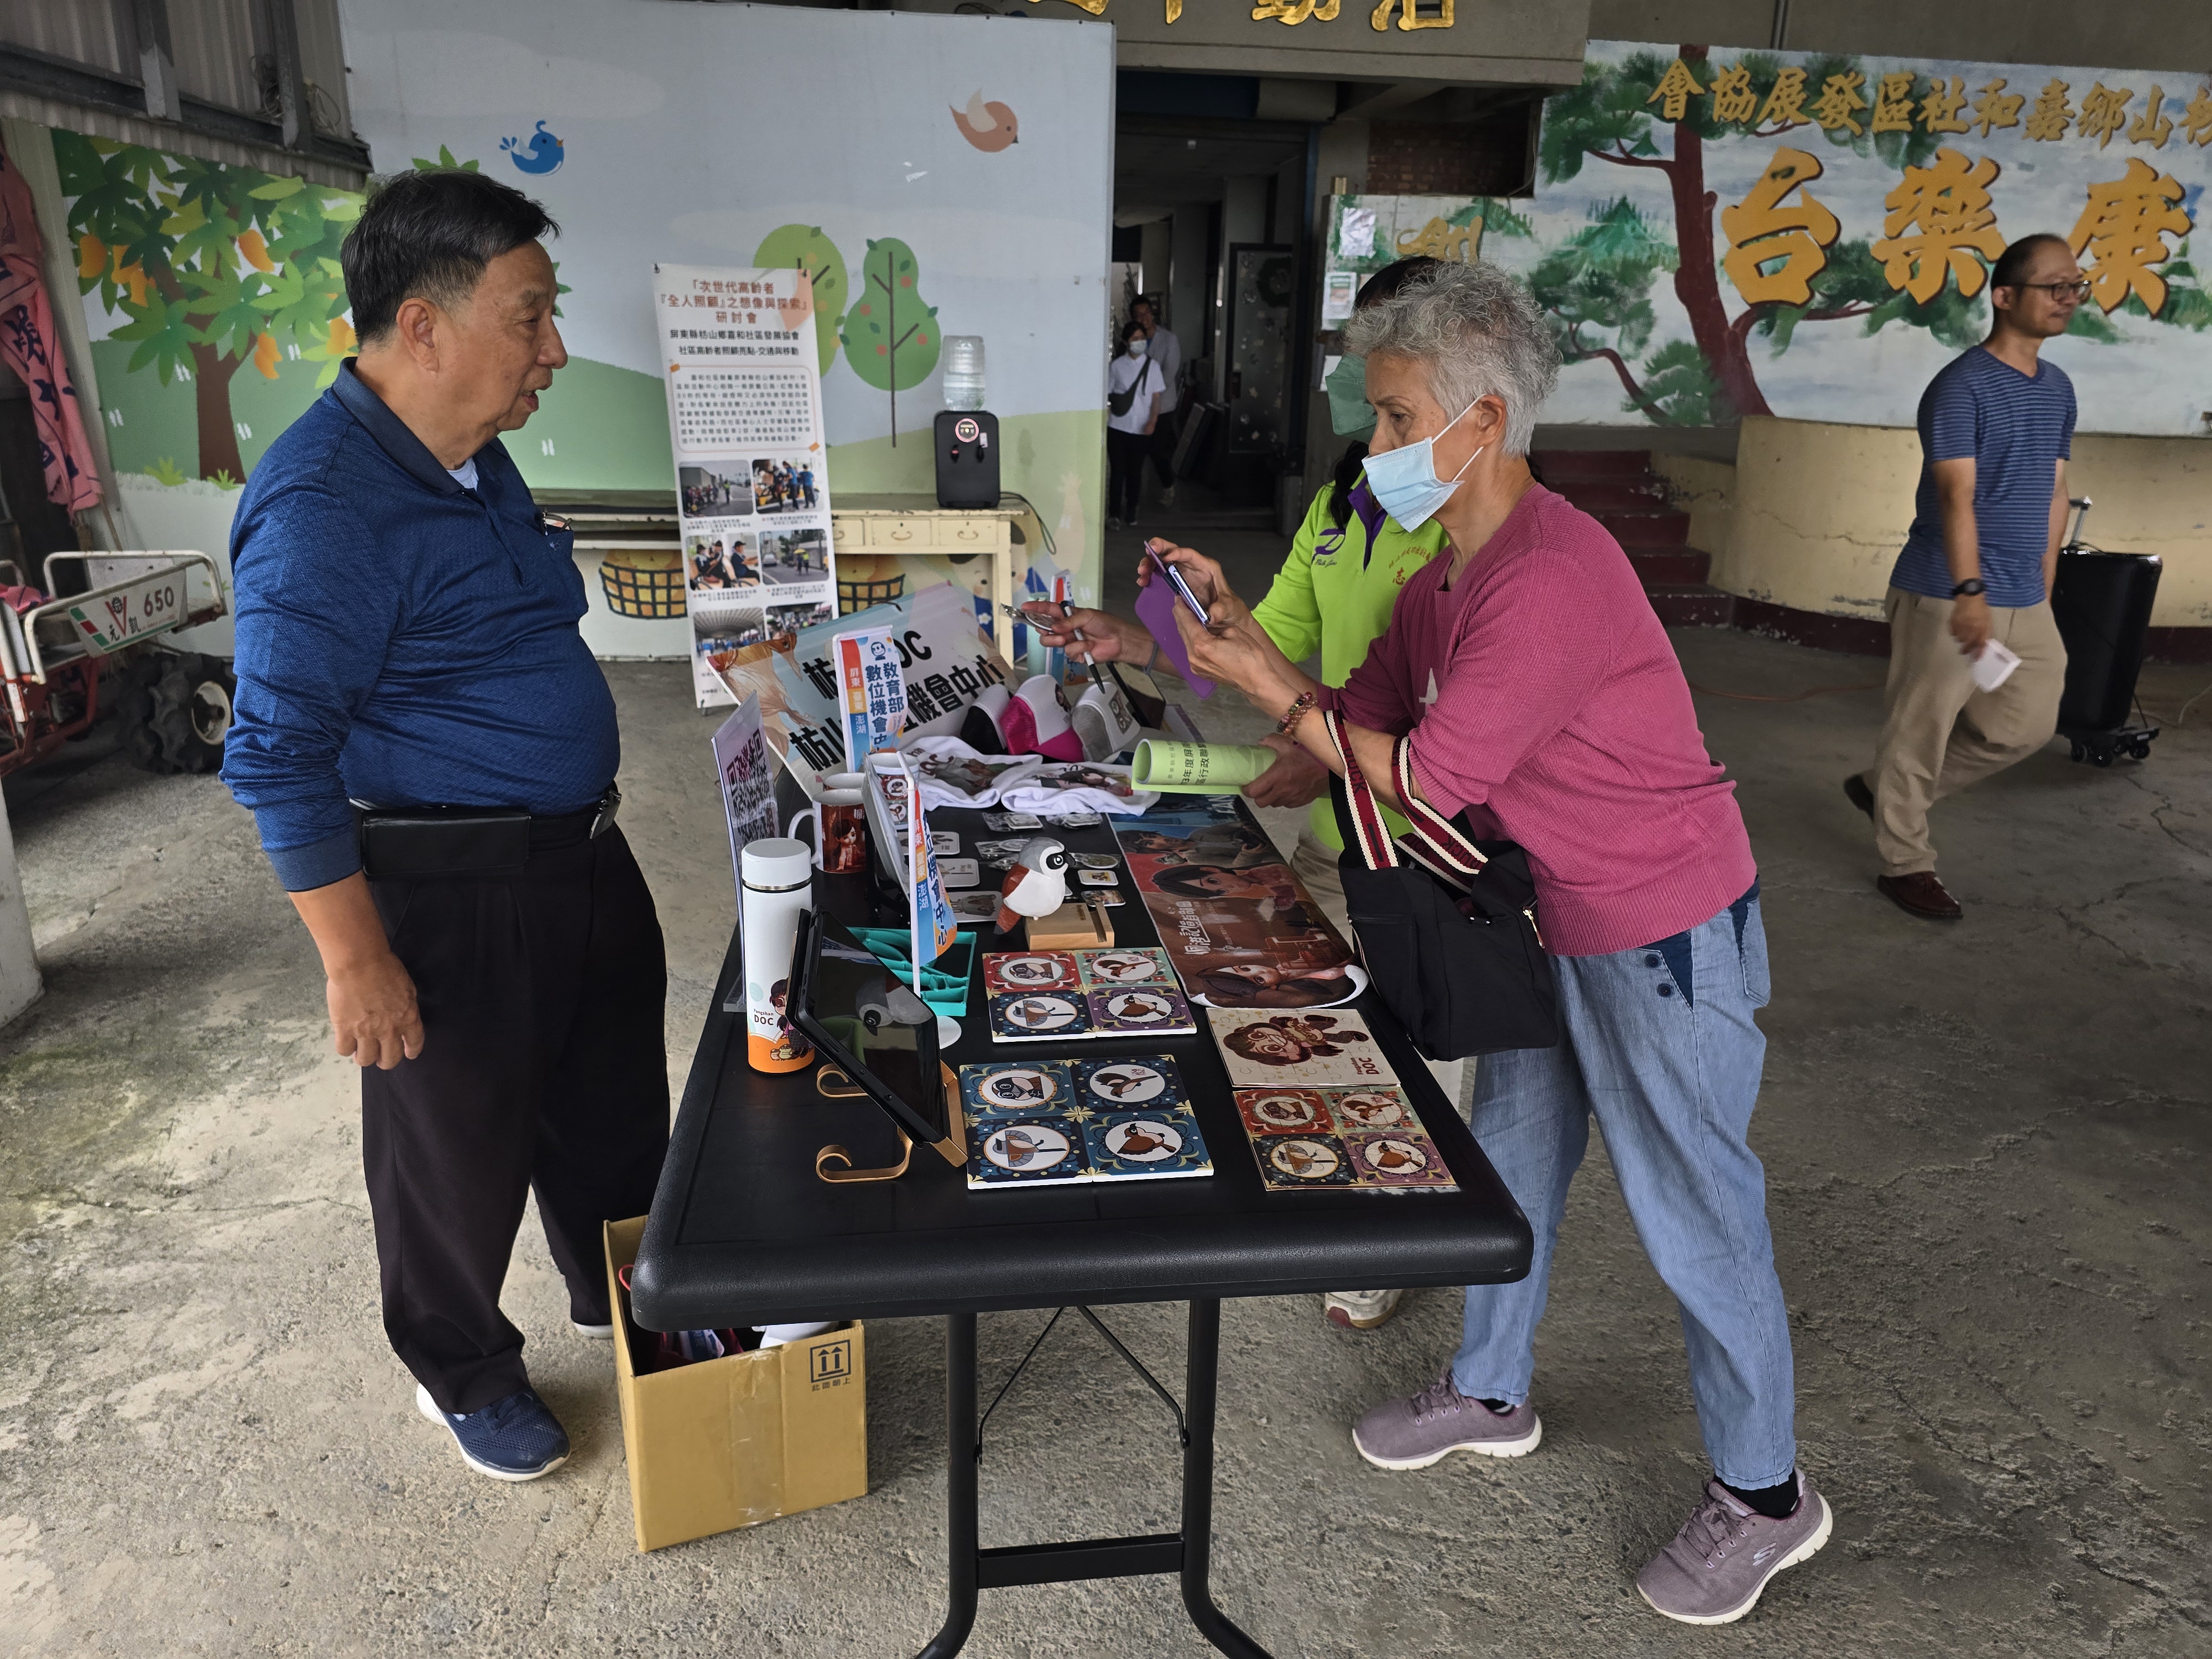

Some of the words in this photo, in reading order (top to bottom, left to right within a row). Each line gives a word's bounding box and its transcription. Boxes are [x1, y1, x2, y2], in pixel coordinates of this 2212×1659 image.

[1720, 145, 2193, 319] 康樂台
[716, 311, 758, 325] 研討會
[144, 585, 175, 618] 650
[850, 667, 861, 687] 屏東
[883, 661, 905, 713] 教育部
[865, 664, 888, 751] 數位機會中
[855, 715, 867, 734] 澎湖
[1442, 836, 1484, 871] DUCK
[917, 882, 929, 911] 澎湖
[754, 1014, 774, 1025] DOC
[1358, 1057, 1380, 1075] DOC
